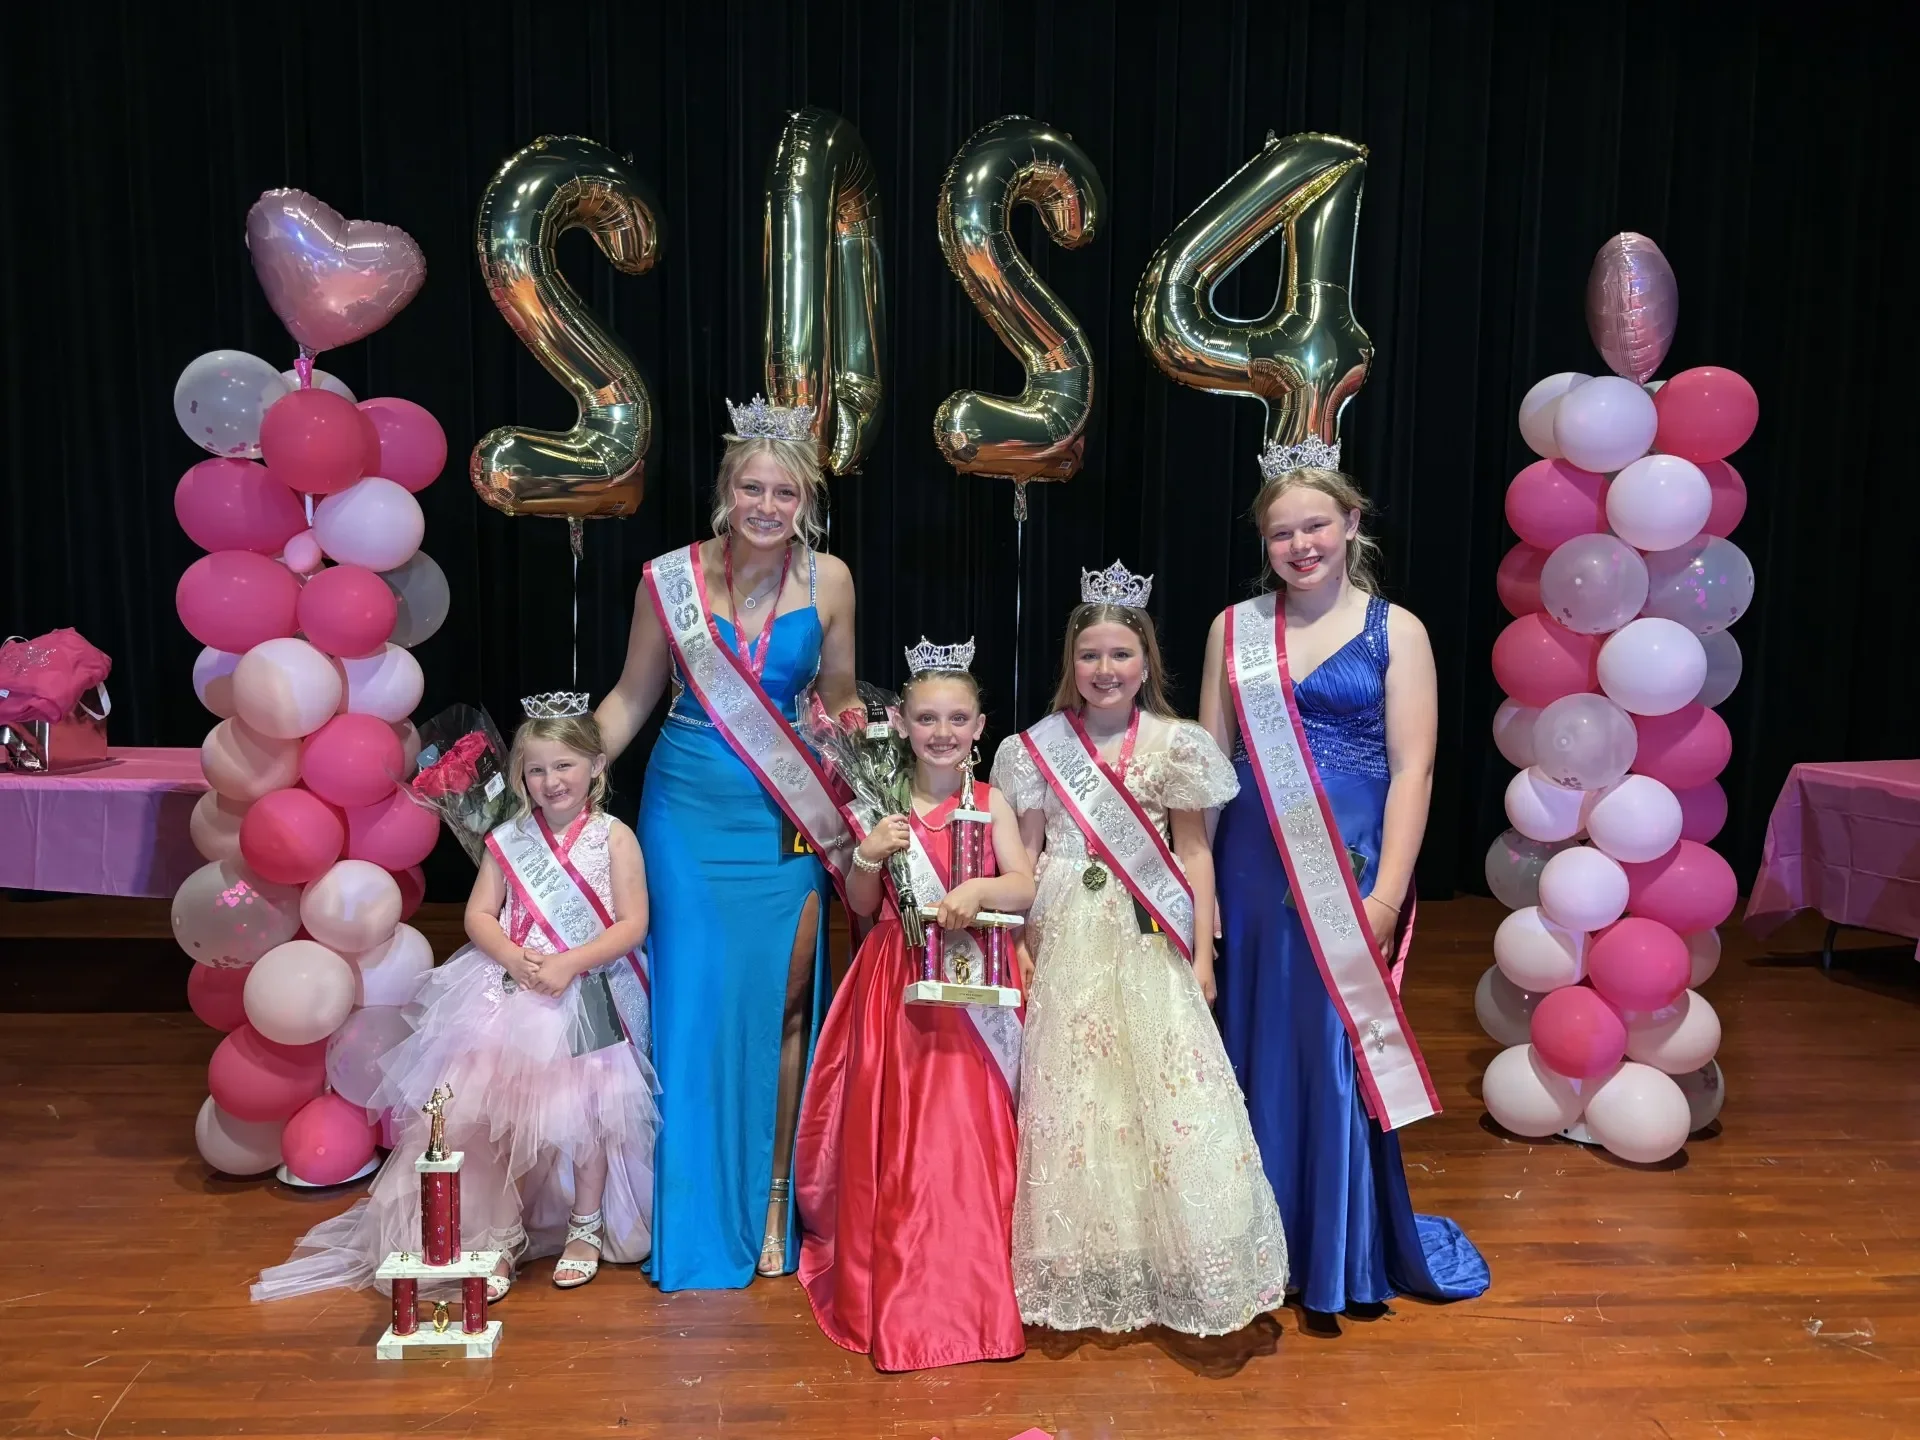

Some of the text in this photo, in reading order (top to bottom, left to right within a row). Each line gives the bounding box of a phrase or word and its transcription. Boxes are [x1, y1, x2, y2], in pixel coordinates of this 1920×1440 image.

[658, 553, 699, 632] MISS
[1243, 672, 1287, 735] MISS
[1046, 736, 1101, 802] JUNIOR
[1090, 796, 1146, 859] MISS
[516, 840, 598, 946] TINY MIS
